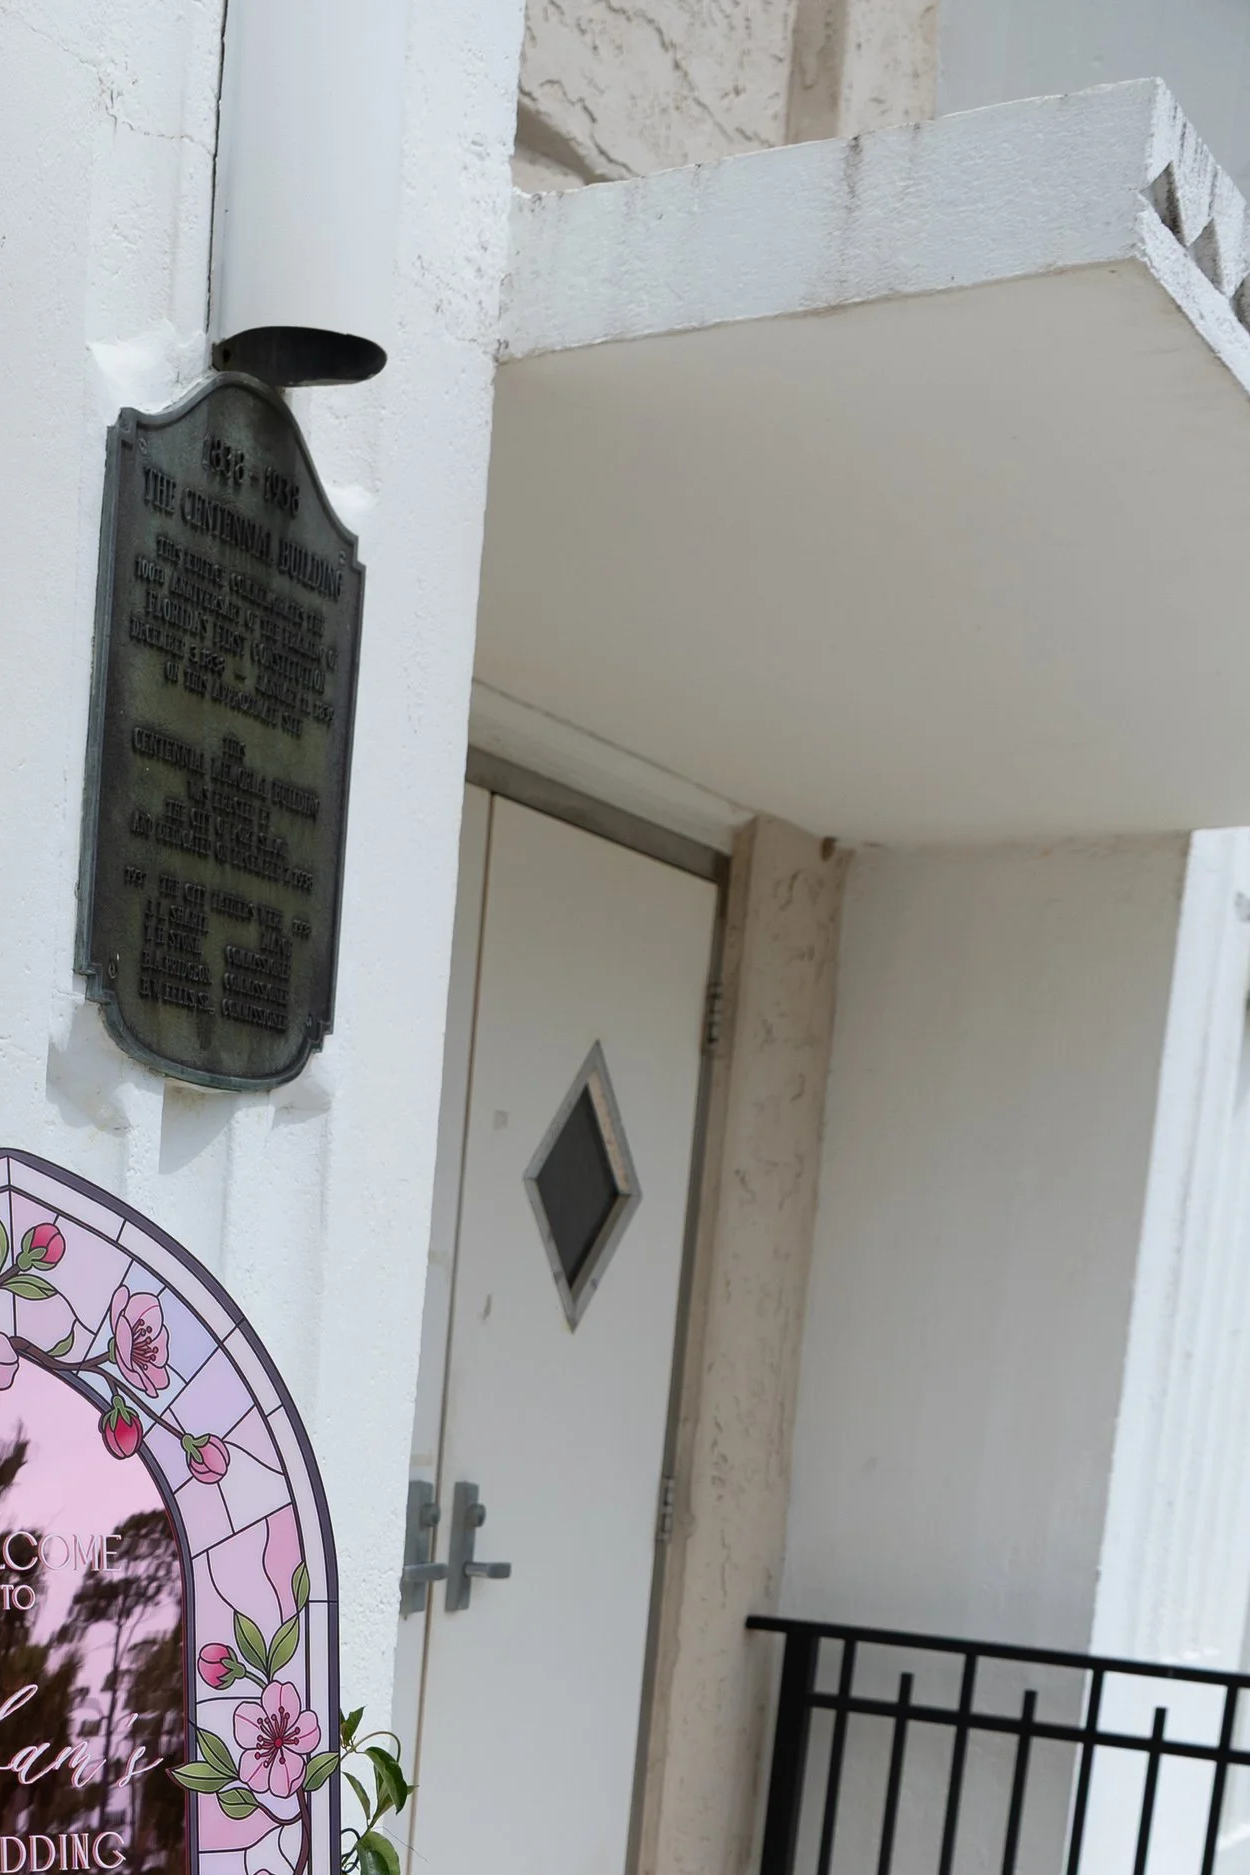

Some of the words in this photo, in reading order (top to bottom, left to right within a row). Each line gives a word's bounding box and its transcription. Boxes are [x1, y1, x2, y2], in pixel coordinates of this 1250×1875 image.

[202, 430, 244, 491] 1838
[263, 464, 300, 520] 1938
[142, 465, 175, 519] THE
[180, 484, 274, 568] CENTENNIAL
[278, 535, 343, 602] BUILDING
[157, 535, 182, 568] THIS
[245, 607, 258, 632] OF
[183, 667, 207, 697] THIS
[212, 620, 247, 658] FIRST
[250, 638, 325, 693] CONSTITUTION
[132, 724, 207, 777] CENTENNIAL
[270, 779, 320, 821] BUILDING
[0, 1584, 36, 1610] TO
